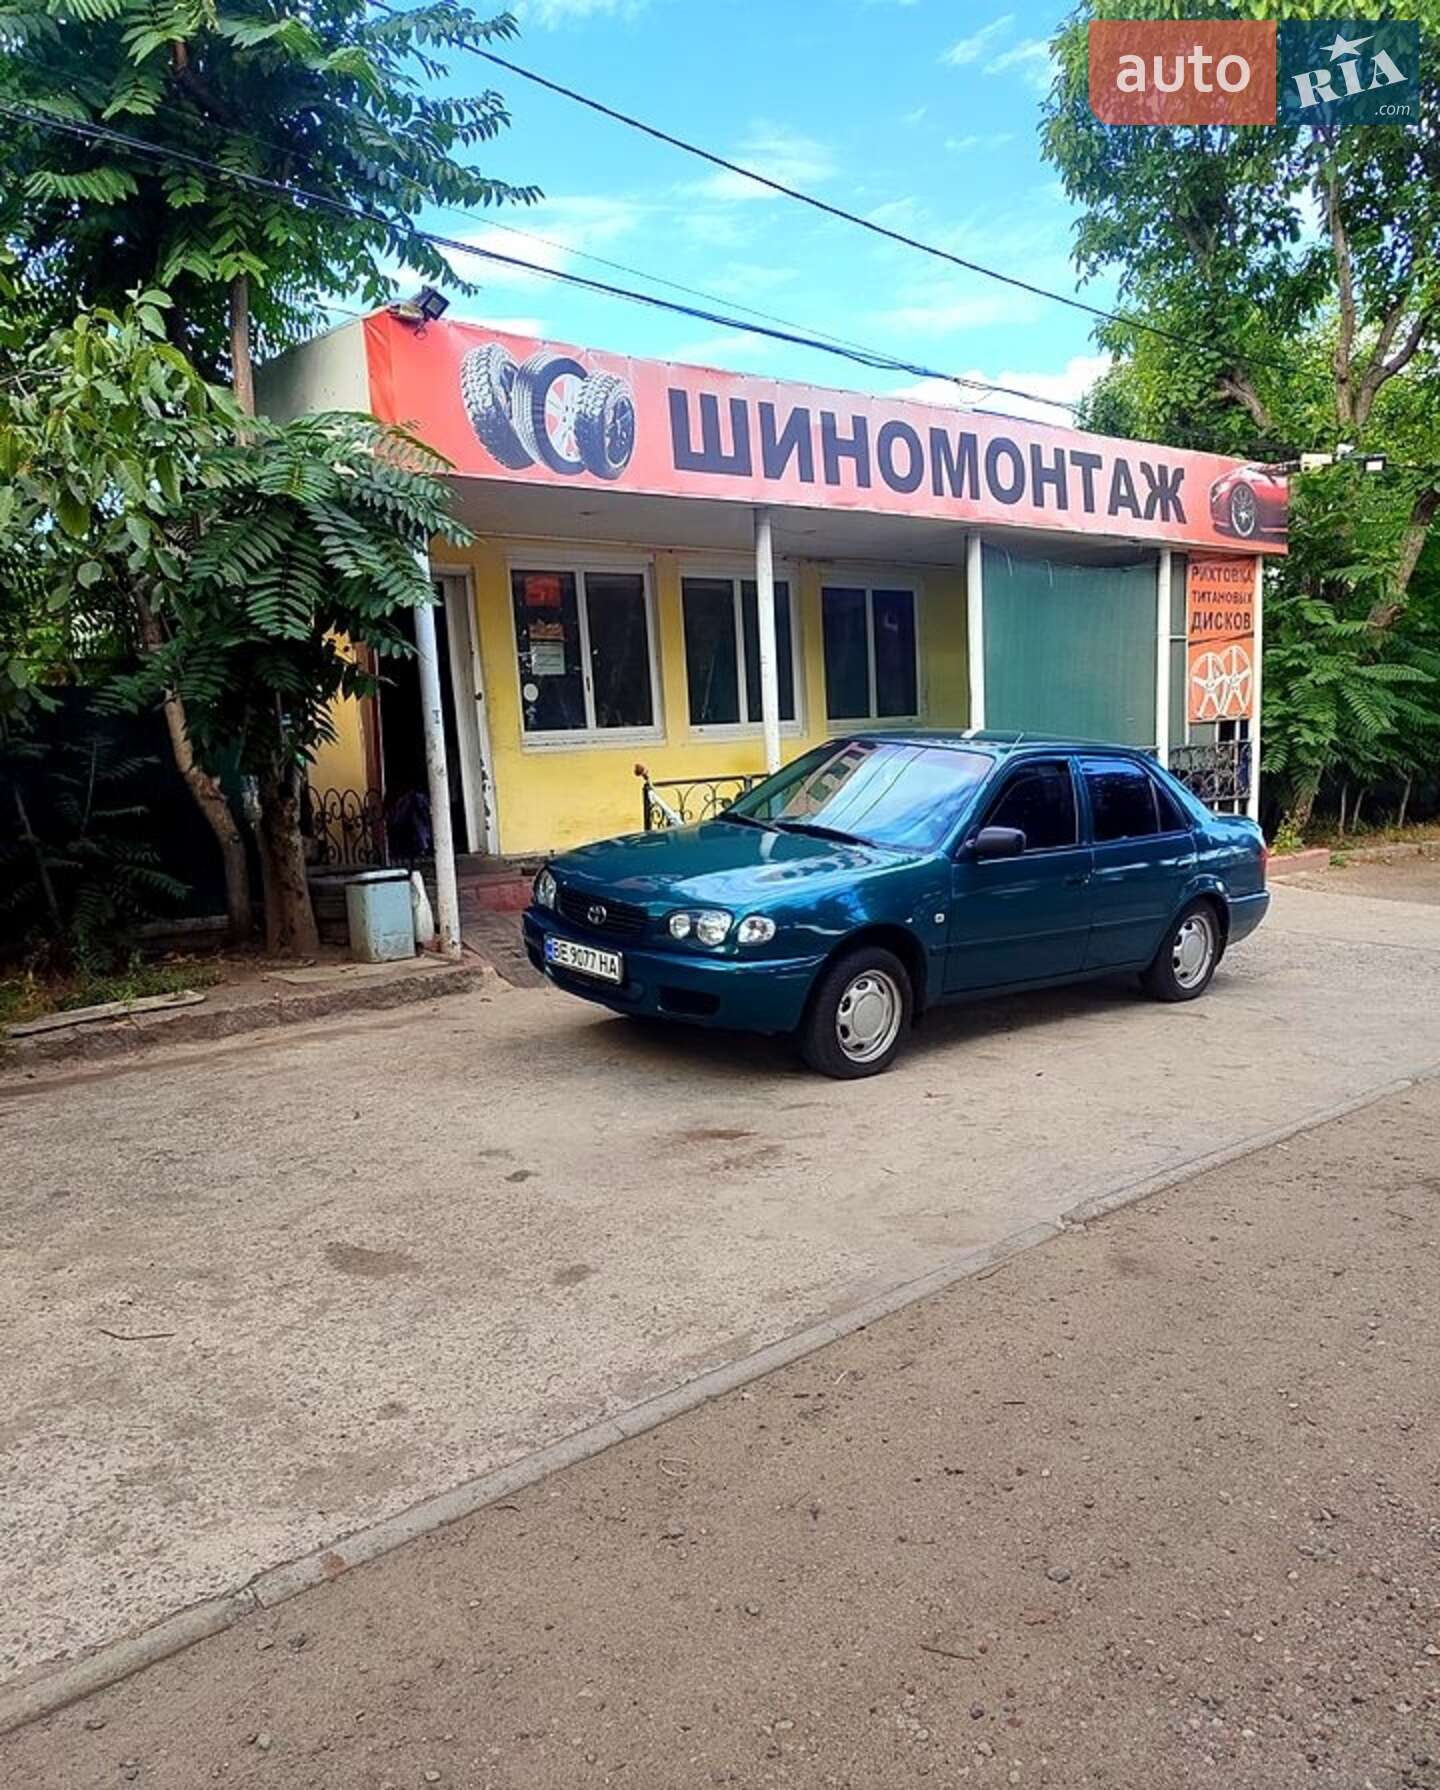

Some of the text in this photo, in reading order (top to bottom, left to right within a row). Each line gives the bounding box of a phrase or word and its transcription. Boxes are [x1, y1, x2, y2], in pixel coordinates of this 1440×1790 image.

[668, 388, 1187, 524] ШИНОМОНТАЖ
[1191, 565, 1254, 584] РИХТОВКА
[1191, 590, 1253, 604] ТИТАНОВЫХ
[1190, 611, 1251, 634] ДИСКОВ
[599, 954, 618, 976] HA
